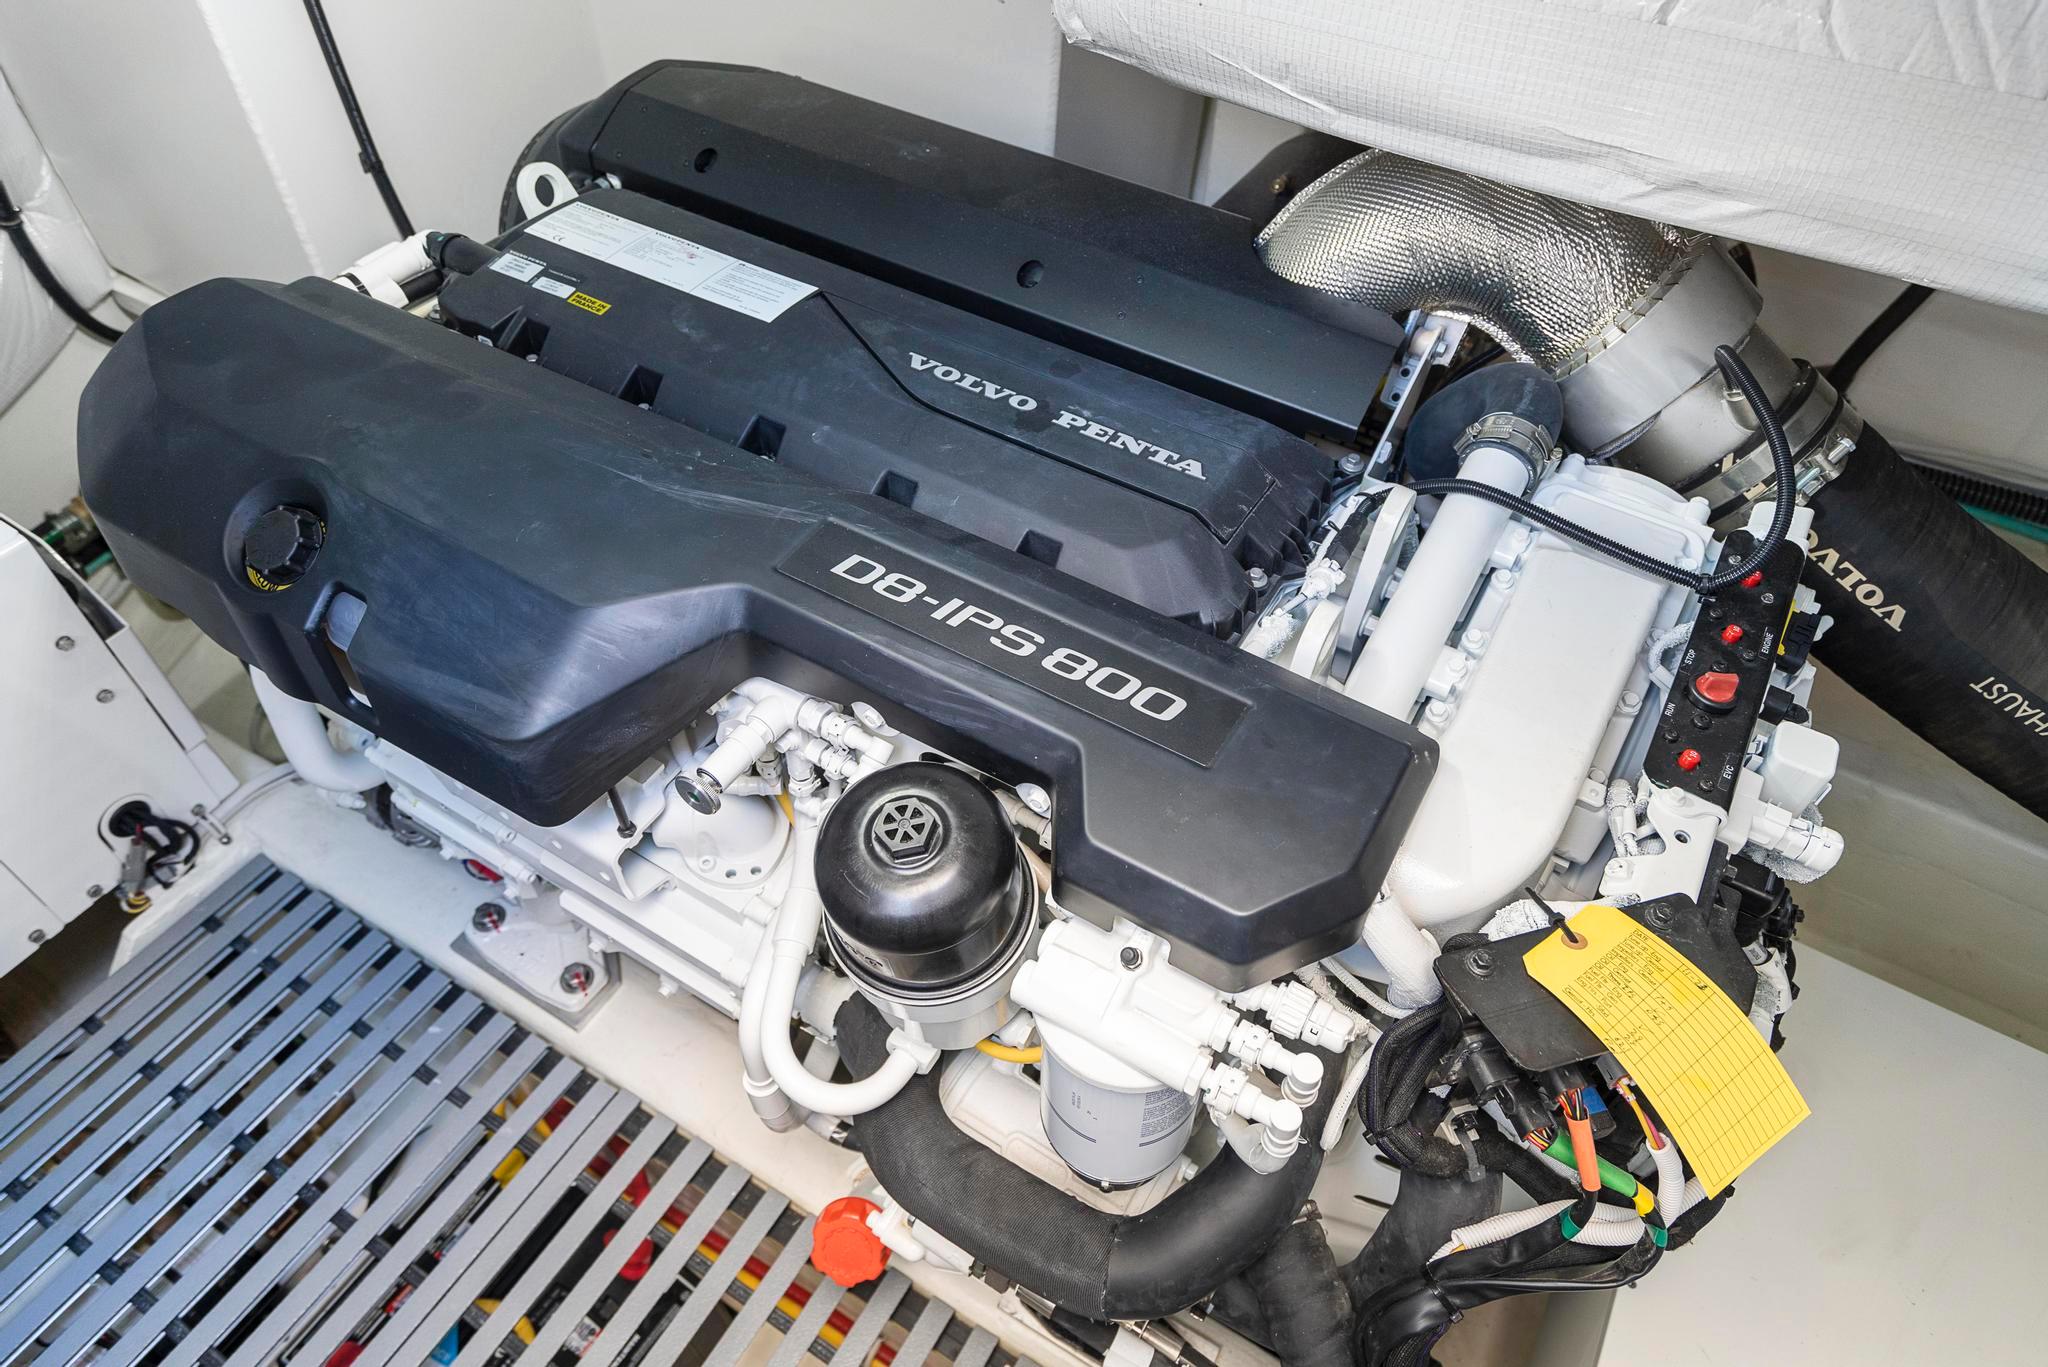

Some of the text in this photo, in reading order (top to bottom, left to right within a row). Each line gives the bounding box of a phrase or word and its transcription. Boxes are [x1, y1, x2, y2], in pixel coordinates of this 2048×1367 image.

[571, 299, 602, 313] FRANCE
[575, 294, 598, 305] MADE
[909, 352, 1207, 480] VOLVO PENTA
[830, 553, 1187, 721] D8-IPS 800
[1762, 632, 1774, 654] ENGINE
[1684, 649, 1696, 665] STOP
[1664, 703, 1676, 716] RUN
[1969, 676, 2048, 736] HAUST
[1723, 765, 1735, 779] EVC
